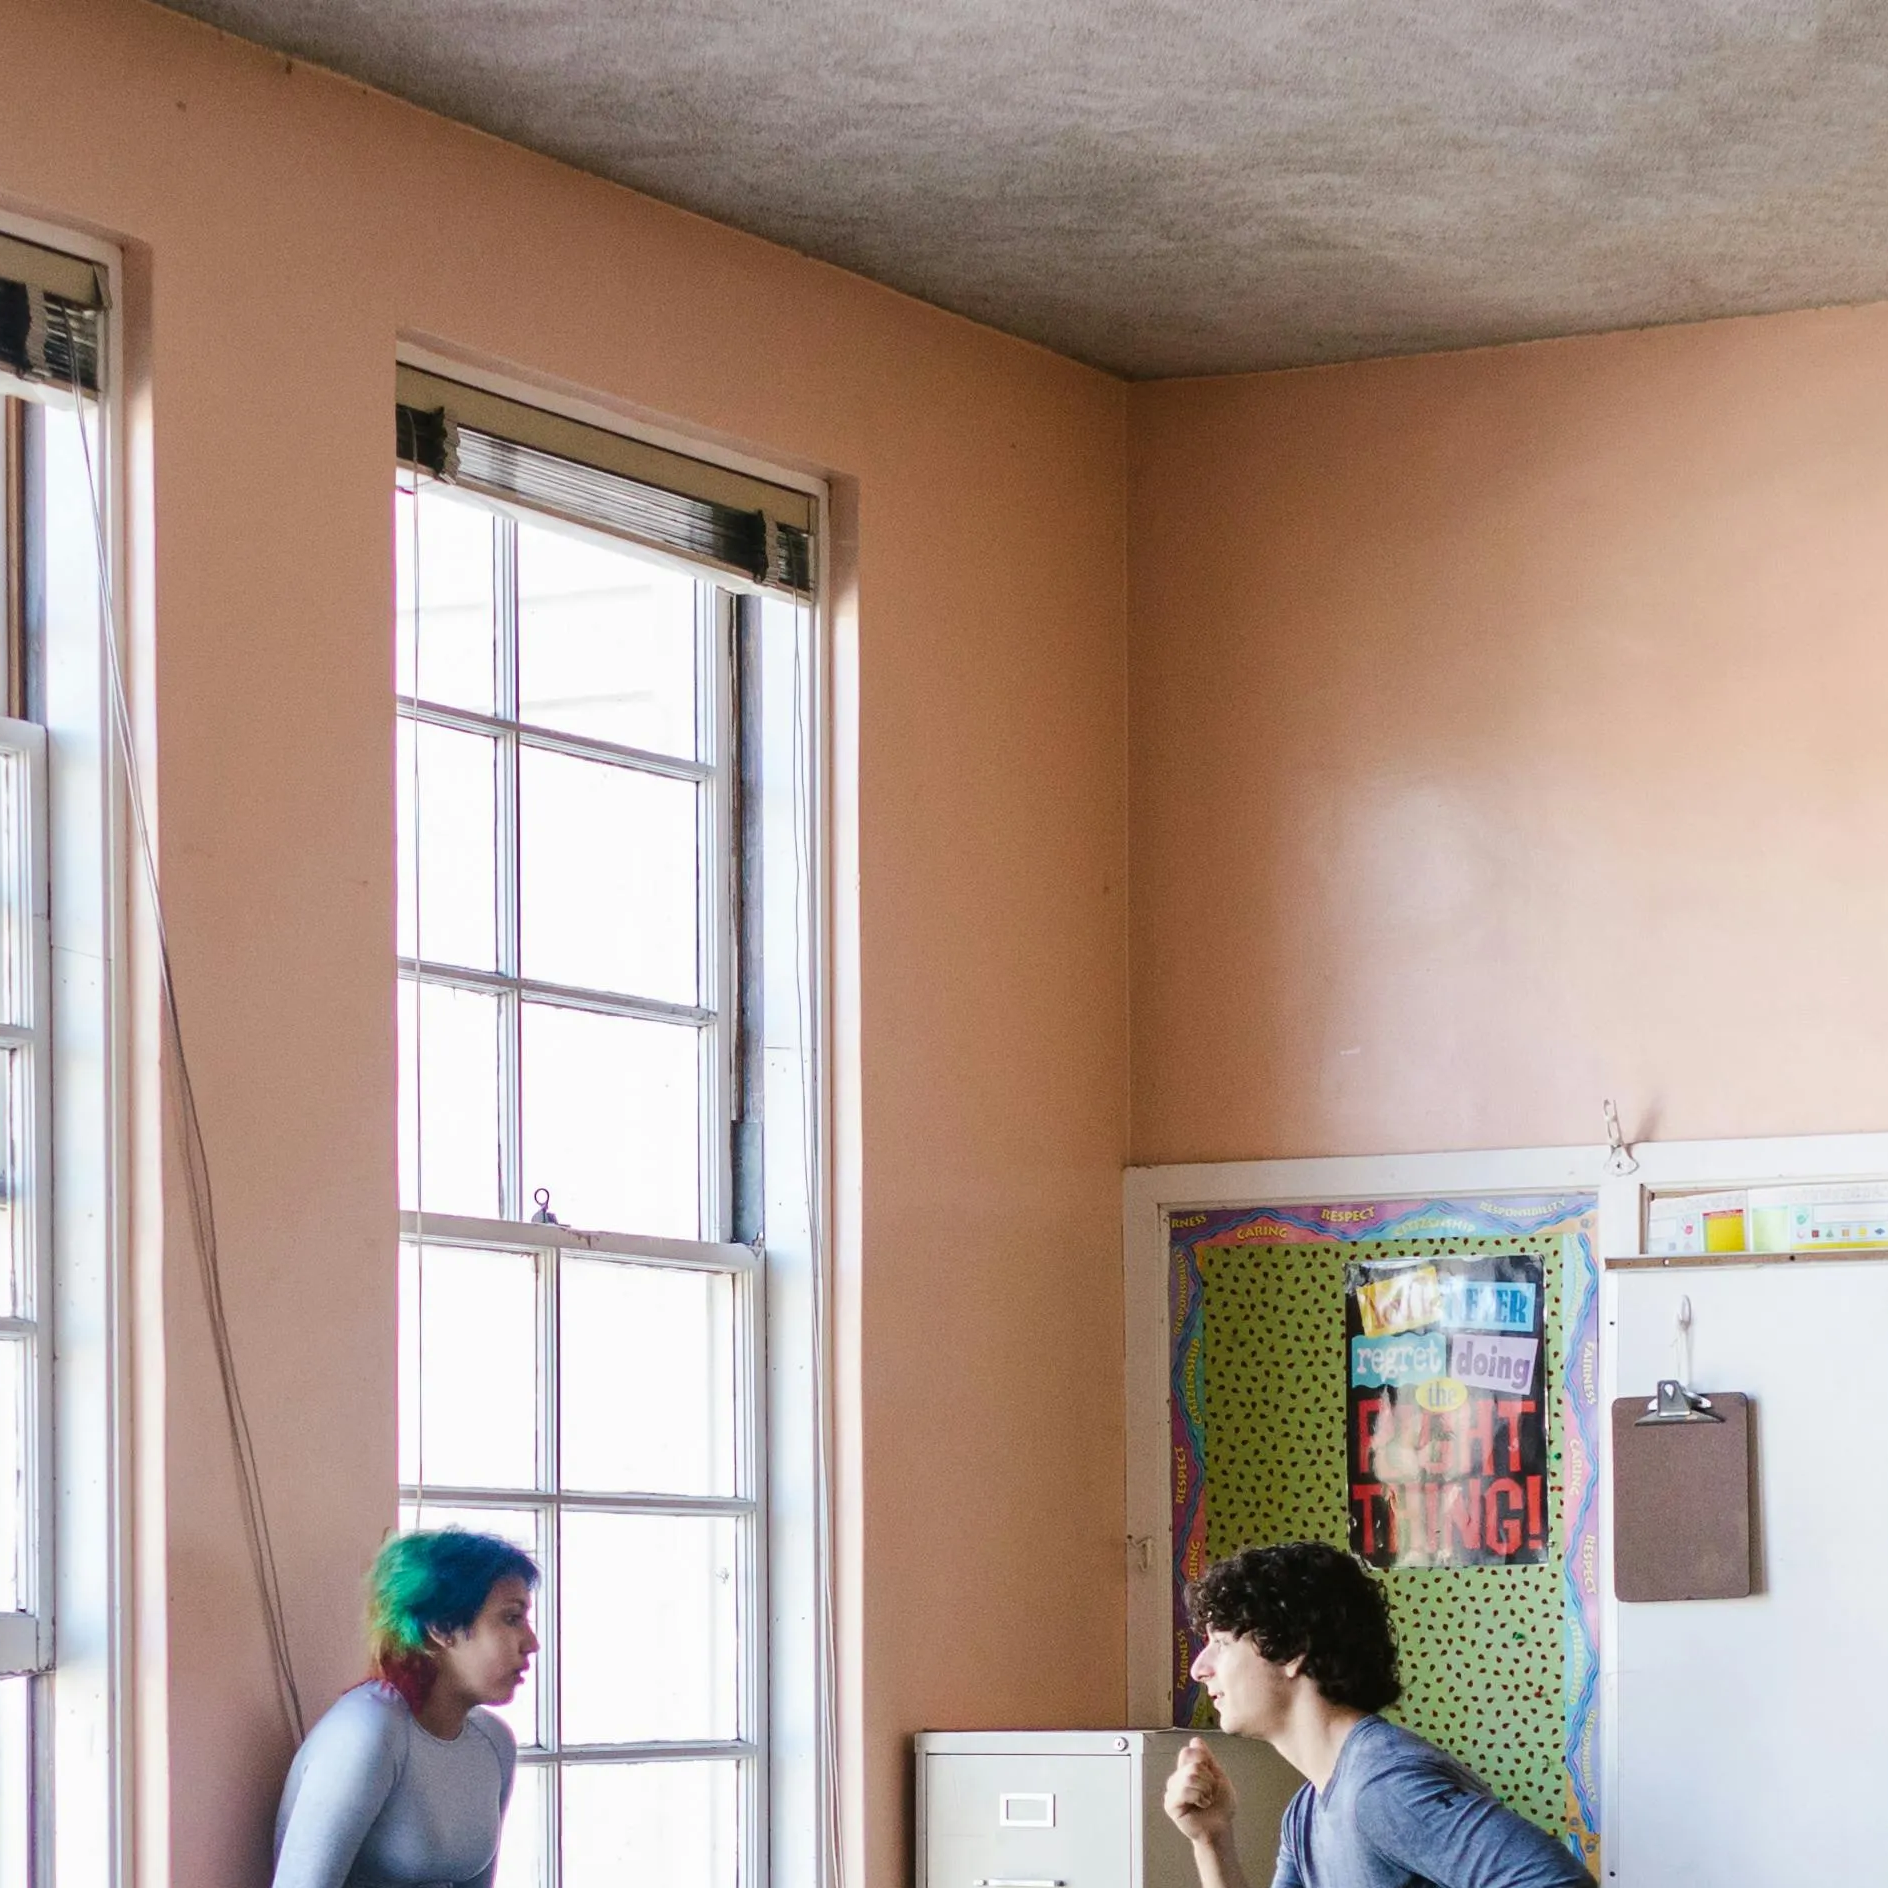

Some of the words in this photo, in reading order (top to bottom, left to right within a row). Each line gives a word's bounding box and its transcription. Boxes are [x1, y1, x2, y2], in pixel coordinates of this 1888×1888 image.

[1171, 1215, 1207, 1230] RNESS
[1236, 1226, 1288, 1239] CARING
[1321, 1206, 1376, 1222] RESPECT
[1393, 1214, 1475, 1236] CITIZENSHIP
[1478, 1199, 1566, 1217] RESPONSIBILITY
[1186, 1338, 1201, 1424] CITIZENSHIP
[1357, 1338, 1441, 1381] regret
[1456, 1342, 1531, 1388] doing
[1583, 1341, 1596, 1405] FAIRNESS
[1428, 1381, 1457, 1407] the
[1175, 1447, 1184, 1504] RESPECT
[1569, 1439, 1583, 1496] CARING
[1353, 1475, 1542, 1556] THING!
[1189, 1541, 1200, 1580] RING
[1583, 1535, 1597, 1594] RESPECT
[1177, 1629, 1190, 1690] FAIRNESS
[1568, 1617, 1583, 1704] CITIZENSHIP
